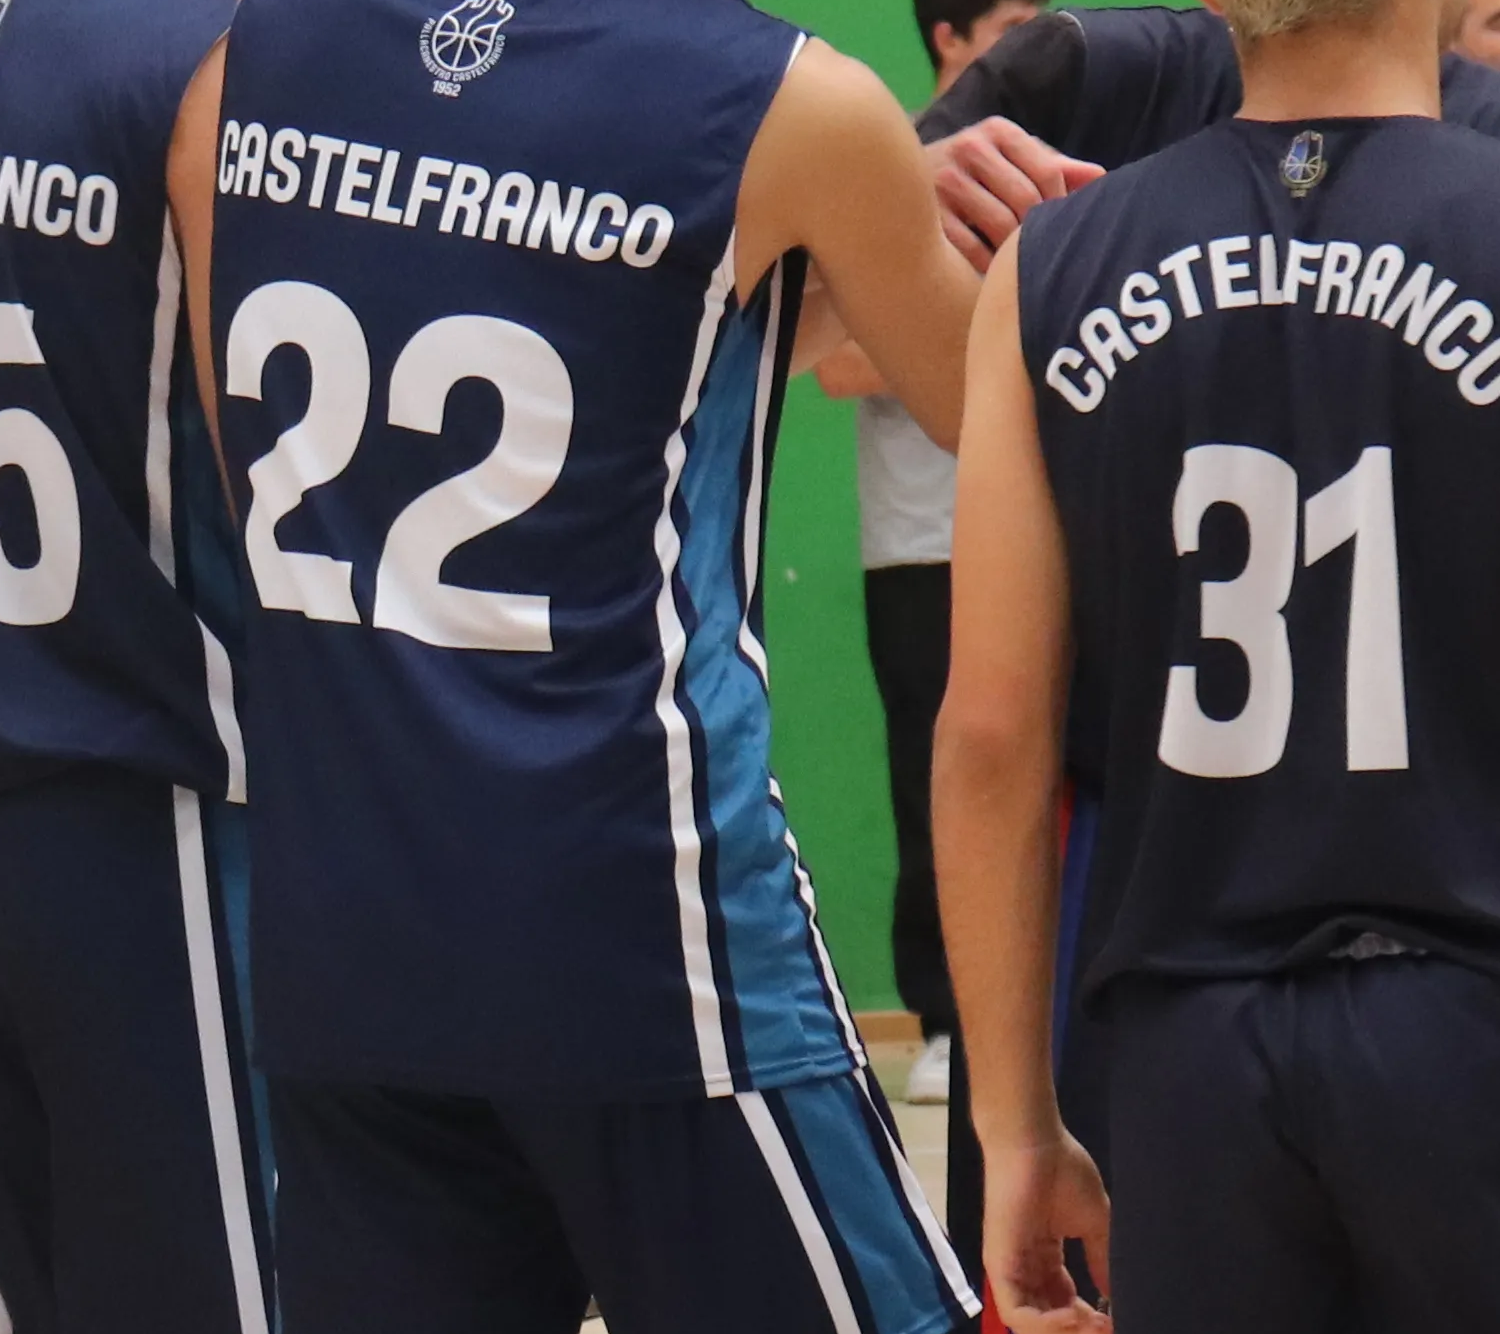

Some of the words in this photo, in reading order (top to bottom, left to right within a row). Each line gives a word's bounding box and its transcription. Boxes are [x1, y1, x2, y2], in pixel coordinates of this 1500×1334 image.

[218, 120, 675, 268] CASTELFRANCO
[432, 80, 461, 97] 1952
[225, 280, 574, 652] 22
[1158, 444, 1409, 778] 31
